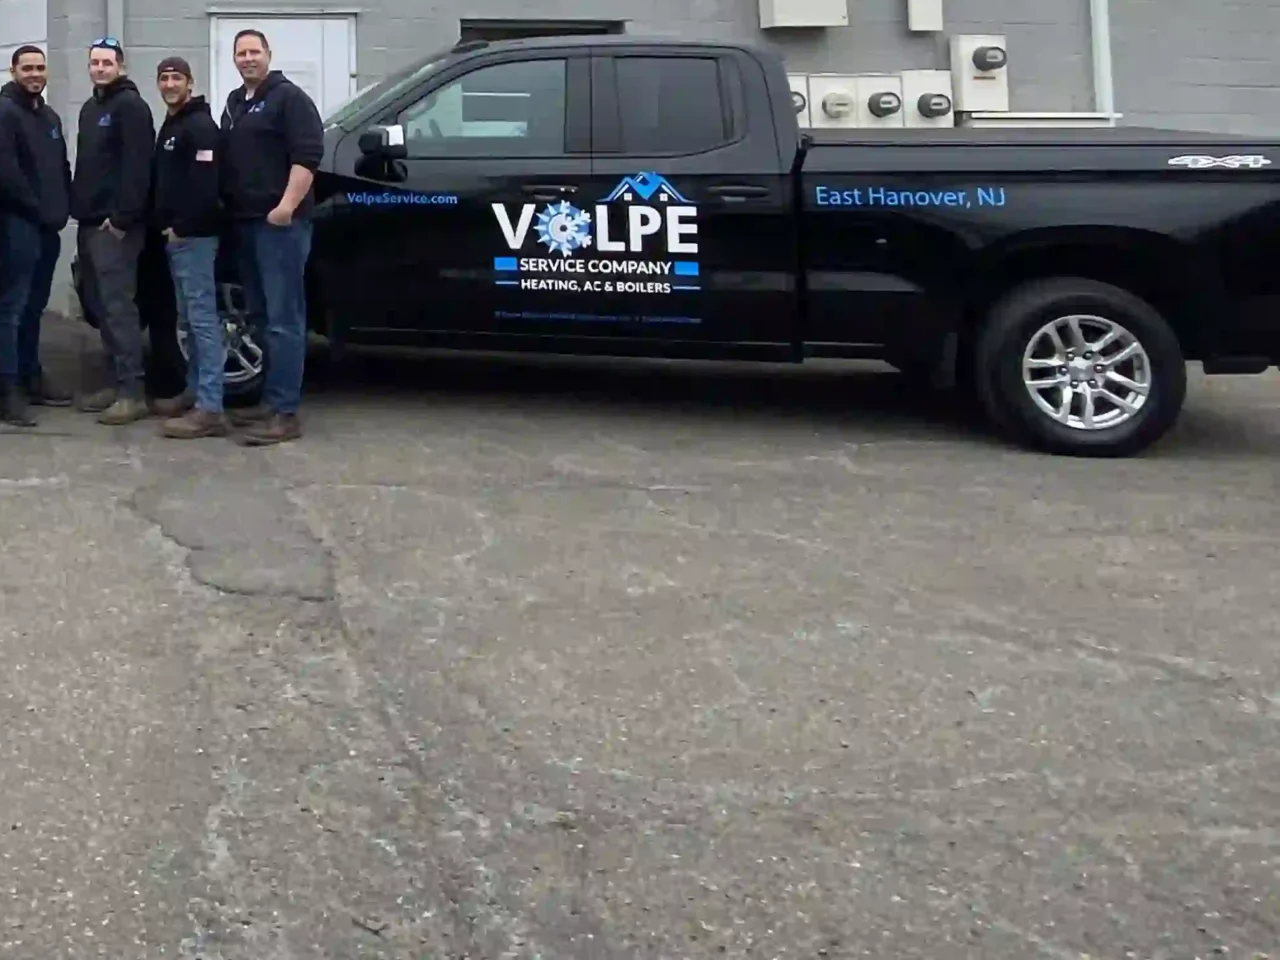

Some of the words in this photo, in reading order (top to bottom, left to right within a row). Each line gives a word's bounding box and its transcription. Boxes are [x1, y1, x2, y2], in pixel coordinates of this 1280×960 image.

[347, 192, 458, 206] VolpeService.com
[816, 186, 862, 205] East
[869, 186, 971, 208] Hanover,
[978, 187, 1005, 206] NJ
[520, 258, 585, 274] SERVICE
[588, 259, 672, 276] COMPANY
[520, 279, 581, 293] HEATING,
[584, 280, 602, 292] AC
[604, 280, 613, 292] &
[616, 281, 671, 294] BOILERS
